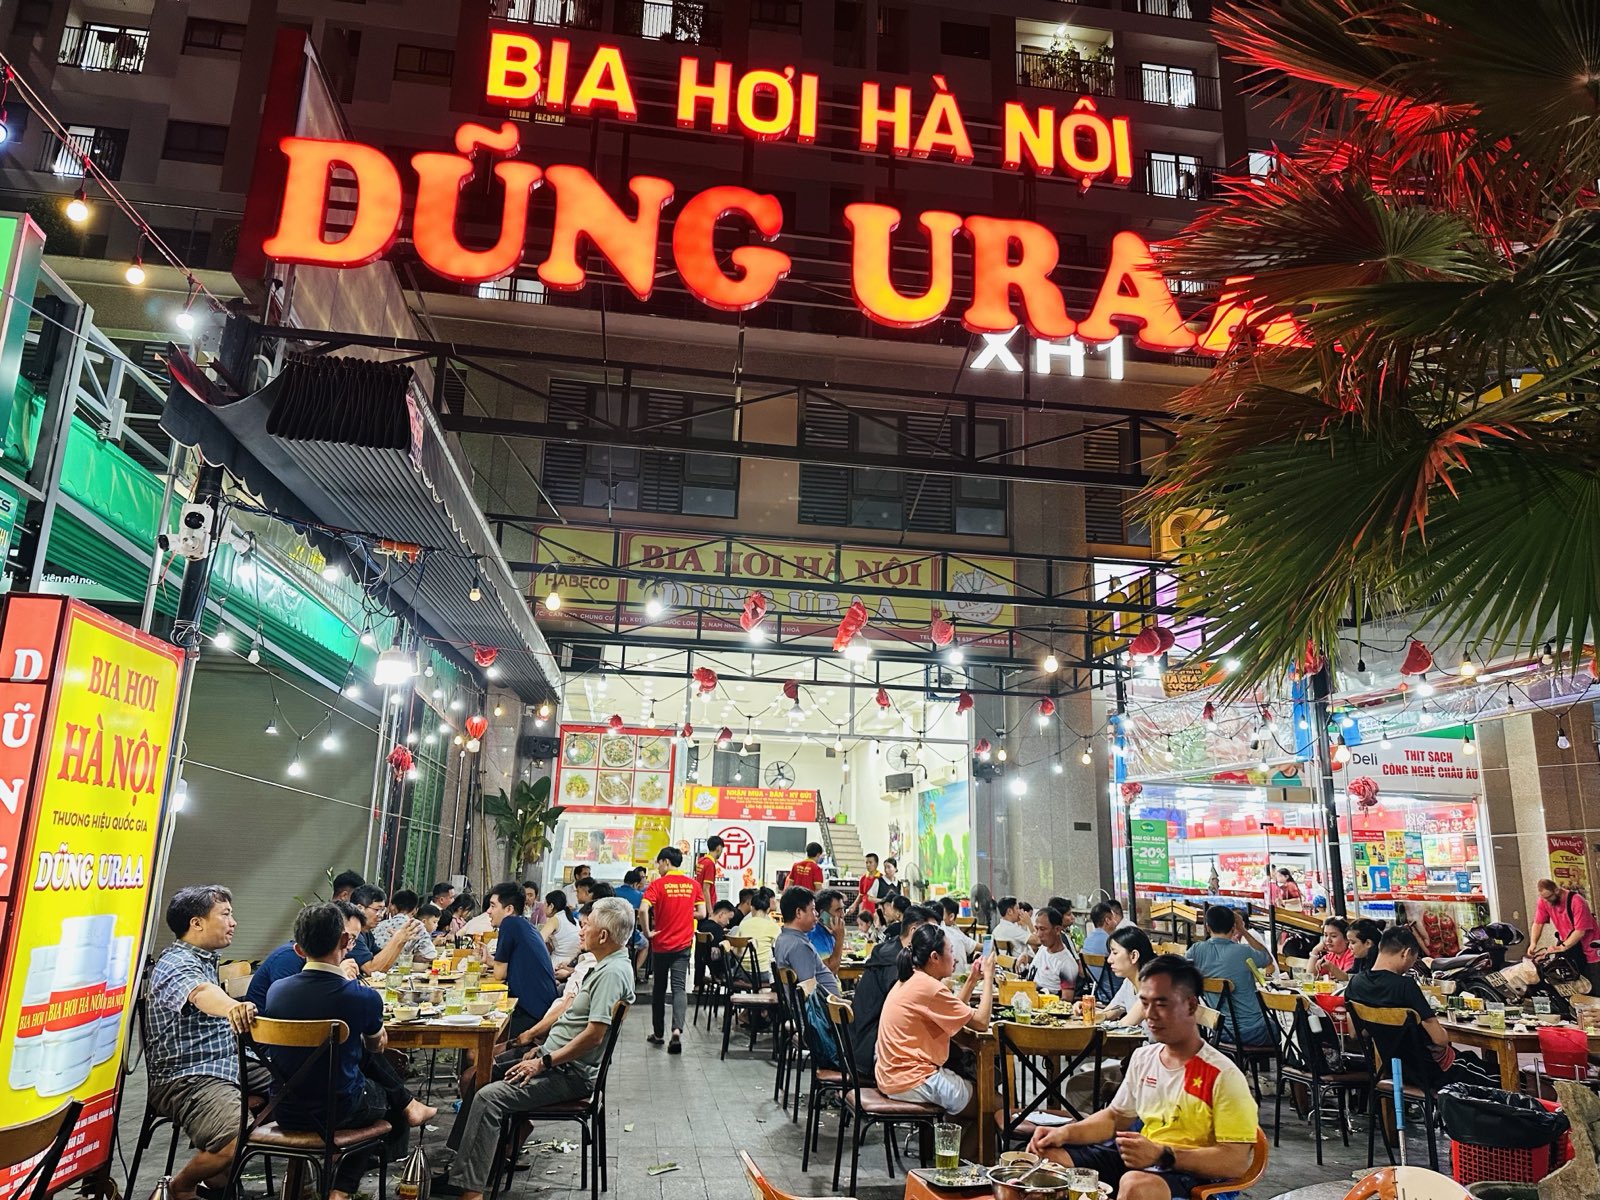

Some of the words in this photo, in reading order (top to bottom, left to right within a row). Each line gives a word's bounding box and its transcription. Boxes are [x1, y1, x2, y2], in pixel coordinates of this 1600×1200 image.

[486, 30, 637, 120] BIA
[677, 56, 819, 142] HƠI
[860, 73, 974, 164] HÀ
[1004, 96, 1134, 192] NỘI
[262, 121, 791, 312] DŨNG
[969, 327, 1124, 380] XH1
[641, 545, 705, 572] BIA
[793, 551, 845, 581] HÀ
[544, 573, 610, 590] HABECO
[88, 656, 121, 701] BIA
[57, 713, 103, 786] HÀ
[106, 729, 161, 806] NỘI
[1352, 753, 1378, 765] Deli
[1404, 750, 1425, 763] THỊT
[1428, 751, 1453, 764] SẠCH
[1382, 763, 1408, 776] CÔNG
[92, 812, 111, 832] HIỆU
[112, 812, 134, 830] QUỐC
[136, 819, 147, 832] GIA
[1139, 847, 1166, 859] 20%
[1550, 838, 1582, 848] WinMart
[34, 842, 94, 891] DŨNG
[97, 854, 144, 891] URAA
[48, 1002, 62, 1021] BIA
[78, 992, 89, 1014] HÀ
[19, 1014, 31, 1030] BIA
